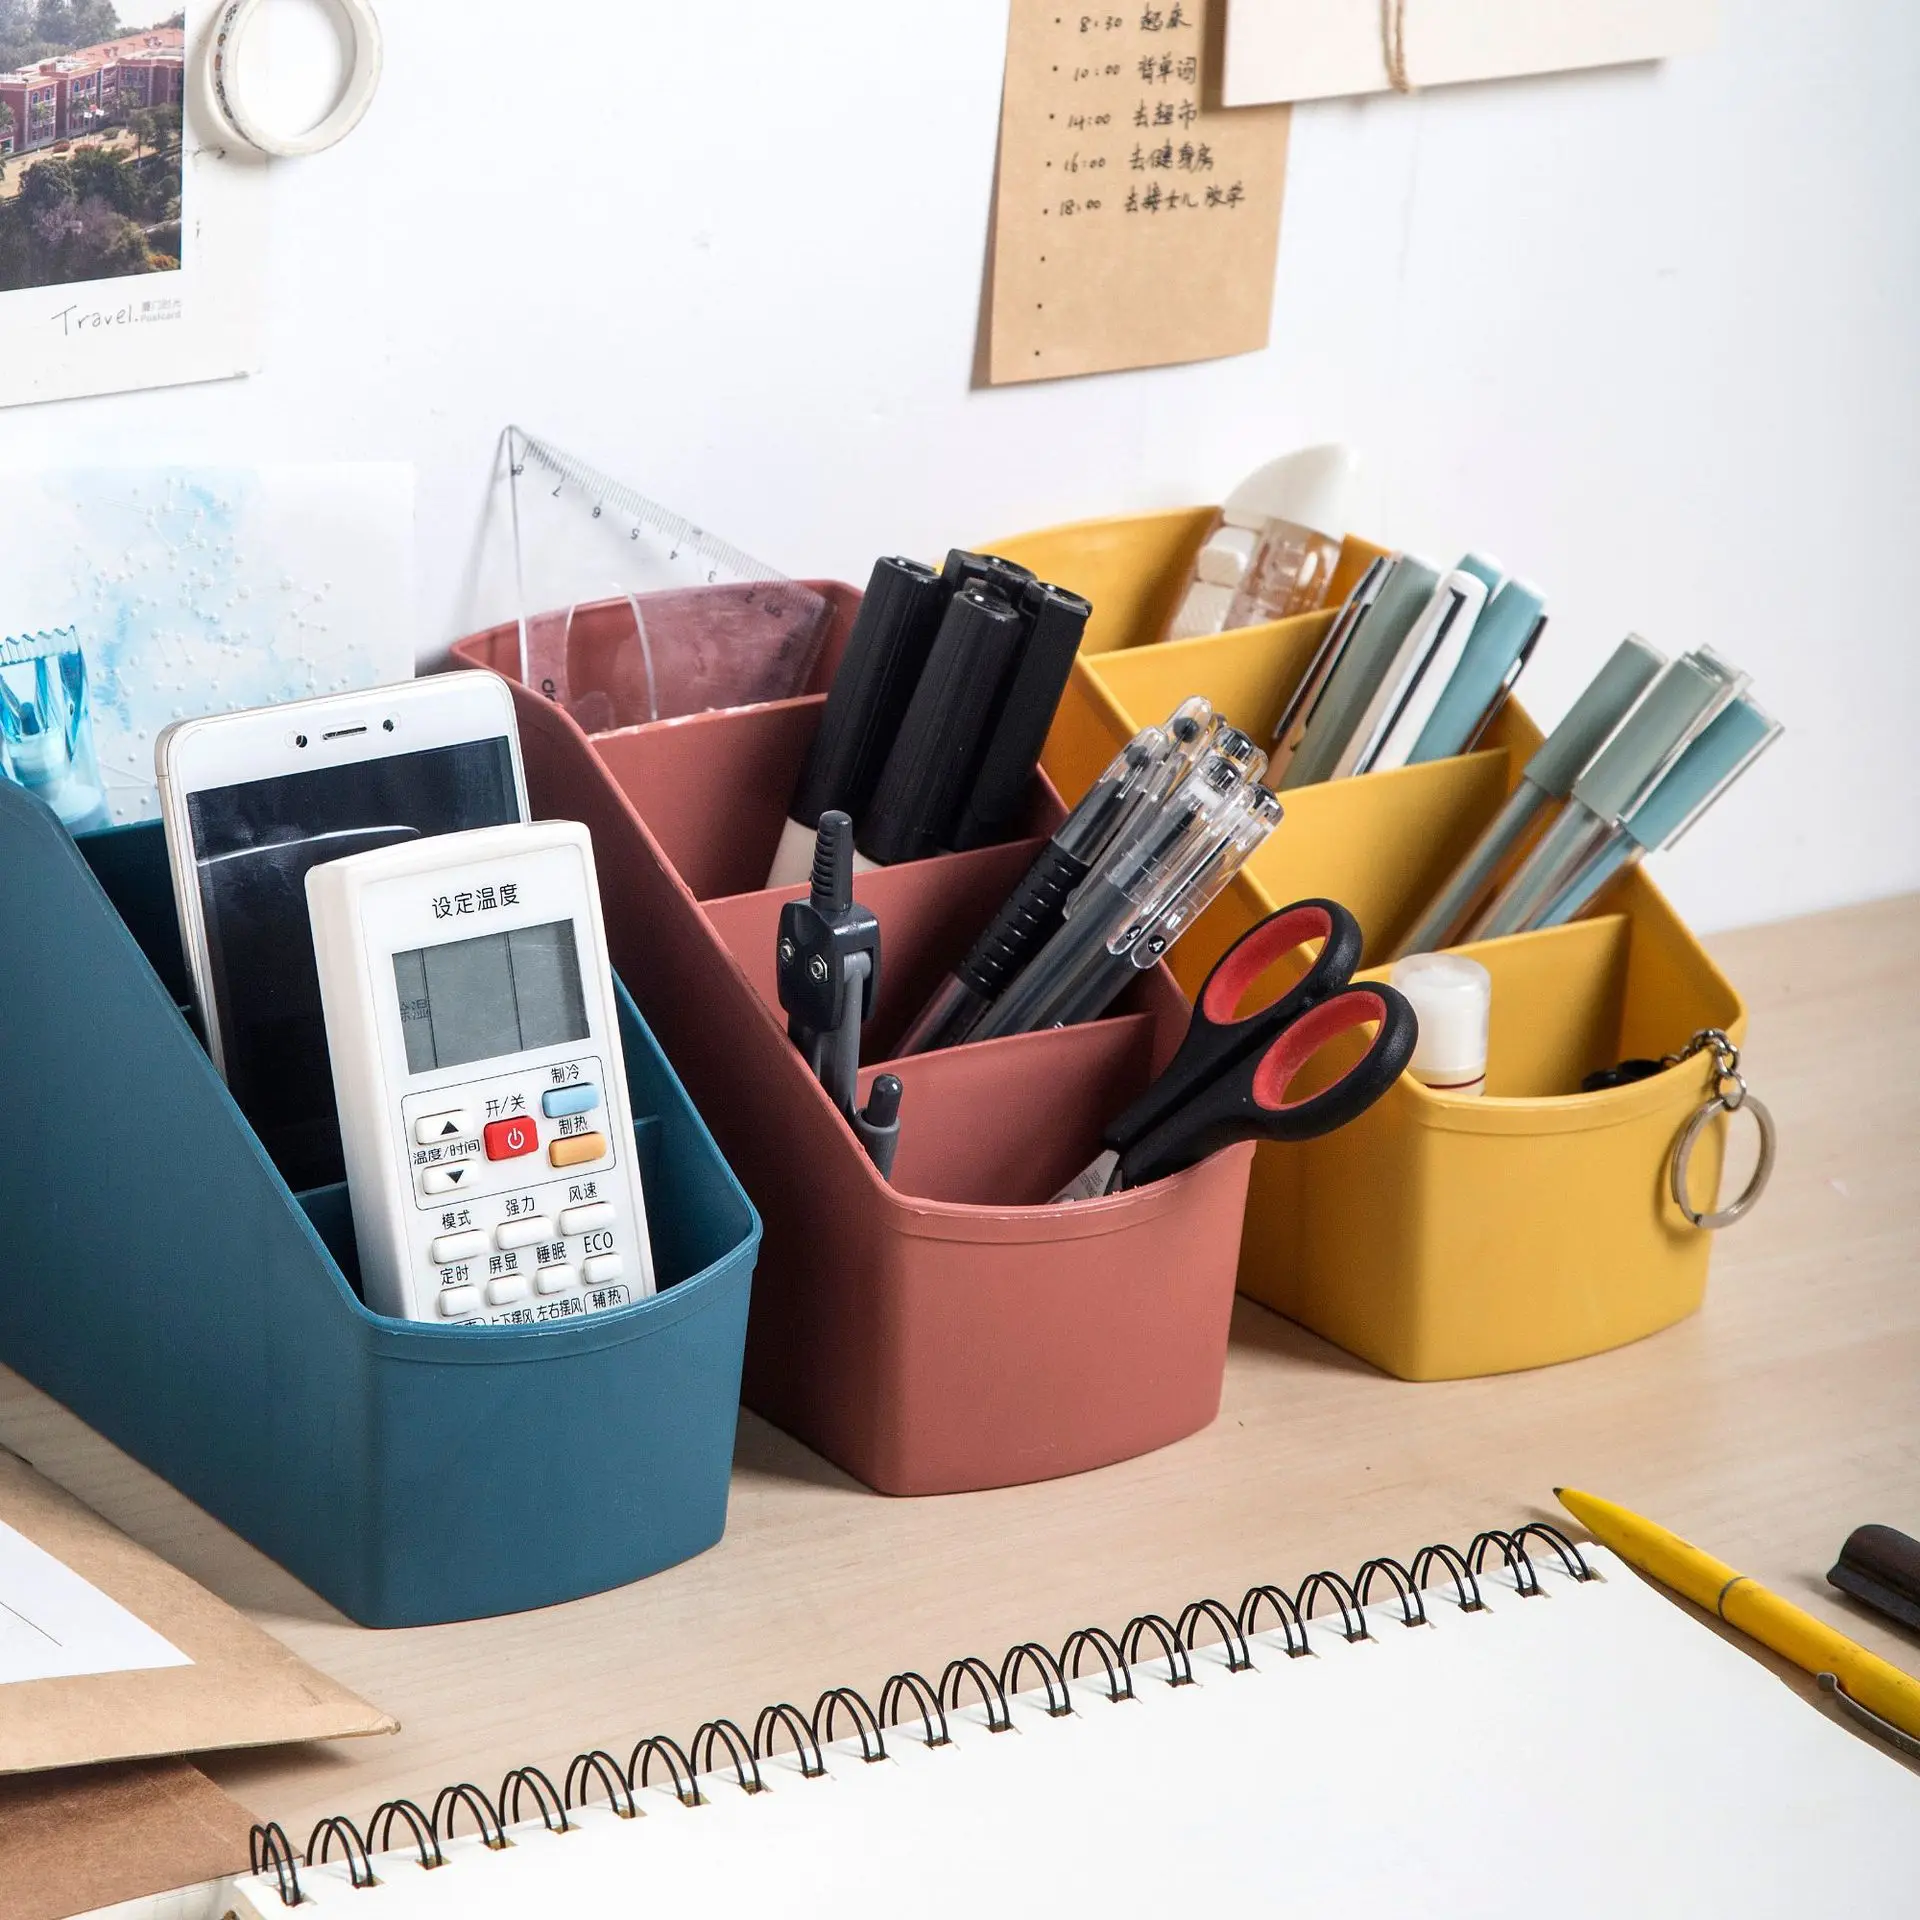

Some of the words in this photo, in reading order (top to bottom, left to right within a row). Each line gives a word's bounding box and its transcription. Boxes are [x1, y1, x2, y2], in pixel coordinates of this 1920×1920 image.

[1079, 16, 1123, 33] 8:30
[1140, 2, 1192, 31] 起床
[1073, 64, 1121, 82] 10:00
[1137, 51, 1197, 85] 背单词
[1067, 113, 1111, 130] 14:00
[1133, 98, 1197, 131] 去超市
[1064, 151, 1106, 173] 16:00
[1129, 137, 1214, 173] 去健身房
[432, 884, 520, 919] 设定温度
[551, 1064, 580, 1084] 制冷
[485, 1093, 526, 1118] 开/关
[558, 1116, 588, 1135] 制热
[413, 1139, 481, 1165] 温度/时间
[569, 1182, 598, 1202] 风速
[505, 1196, 535, 1216] 强力
[441, 1210, 471, 1229] 模式
[536, 1242, 567, 1264] 睡眠
[584, 1231, 614, 1253] ECO
[489, 1254, 518, 1274] 屏显
[440, 1265, 469, 1286] 定时
[537, 1298, 583, 1322] 左右摆风
[592, 1289, 621, 1309] 辅热
